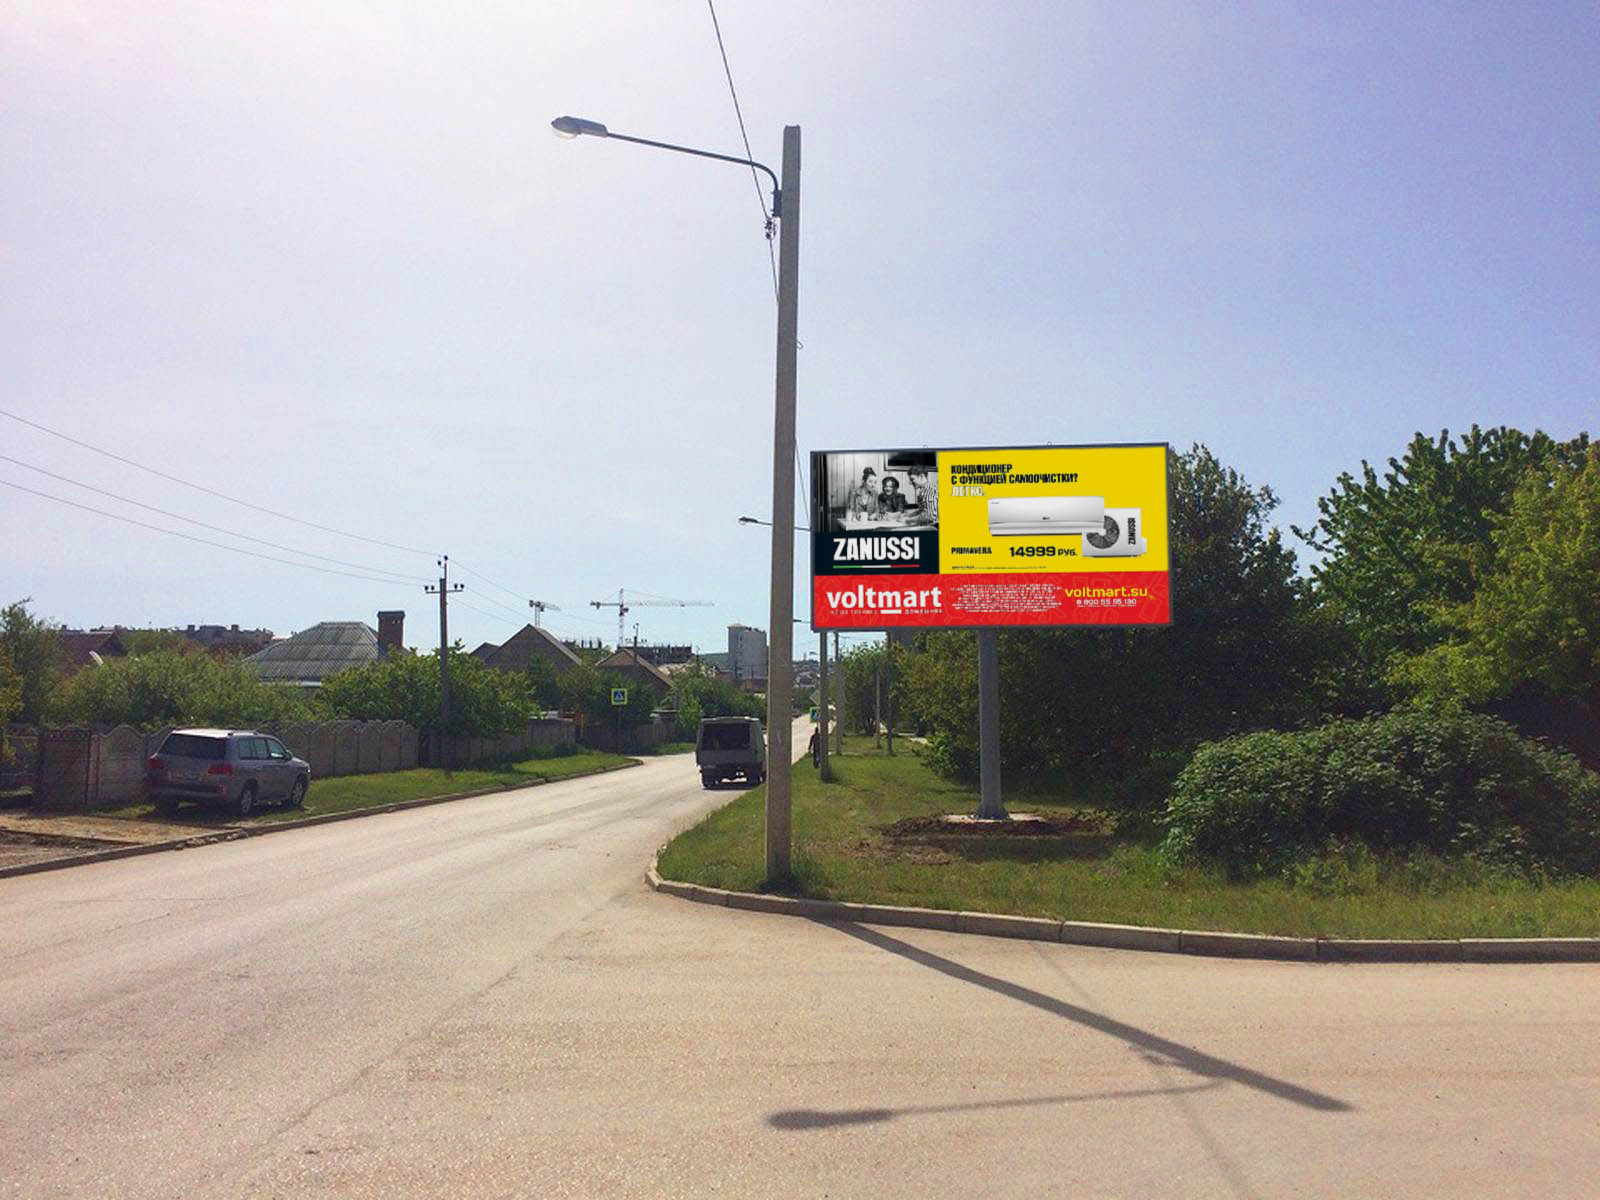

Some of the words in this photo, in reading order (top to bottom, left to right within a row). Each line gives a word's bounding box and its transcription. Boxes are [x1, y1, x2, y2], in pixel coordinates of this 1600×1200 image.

[951, 464, 1012, 475] КОНДИЦИОНЕР
[951, 475, 957, 485] С
[959, 473, 1006, 485] ФУНКЦИЕЙ
[1009, 473, 1078, 484] САМООЧИСТКИ?
[833, 537, 920, 561] ZANUSSI
[951, 546, 992, 555] PRIMAVERA
[1009, 546, 1056, 557] 14999
[826, 584, 942, 609] voltmart
[1064, 586, 1148, 598] voltmart.su
